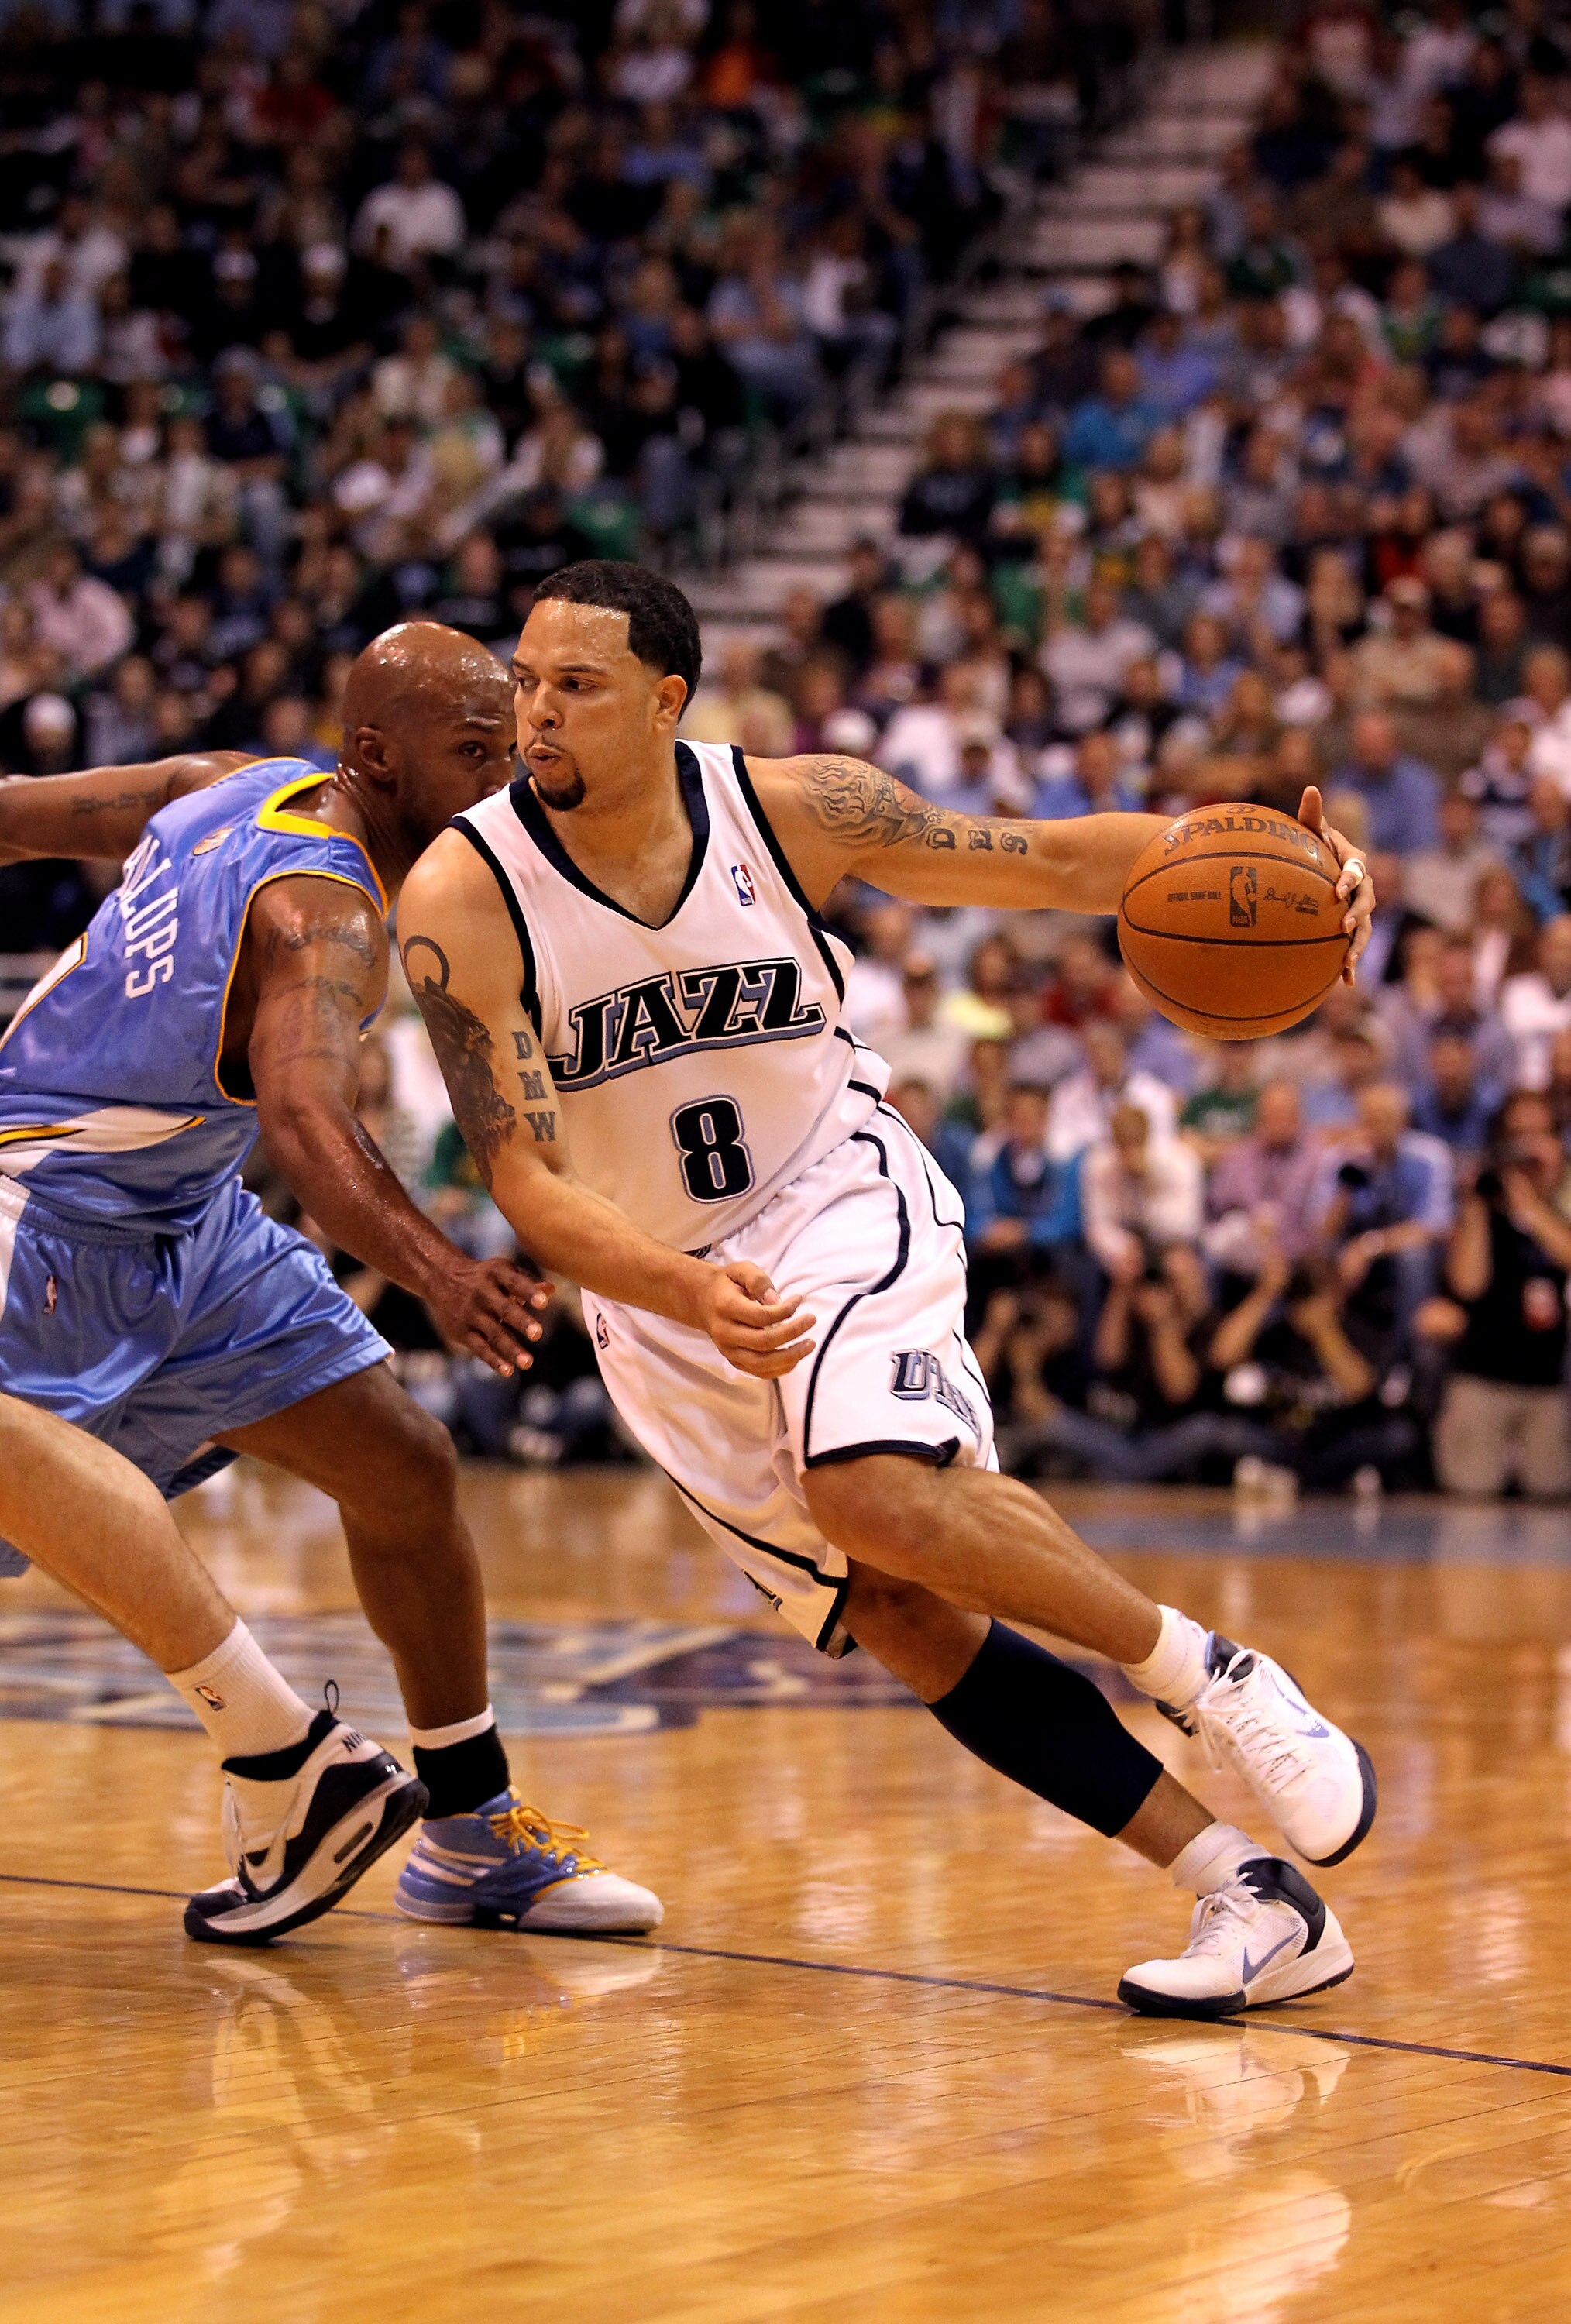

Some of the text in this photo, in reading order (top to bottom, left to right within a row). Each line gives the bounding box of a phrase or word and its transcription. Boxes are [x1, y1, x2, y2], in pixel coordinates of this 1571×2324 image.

[1164, 816, 1319, 861] SPALDING
[548, 957, 827, 1092] JAZZ
[669, 1093, 756, 1205] 8
